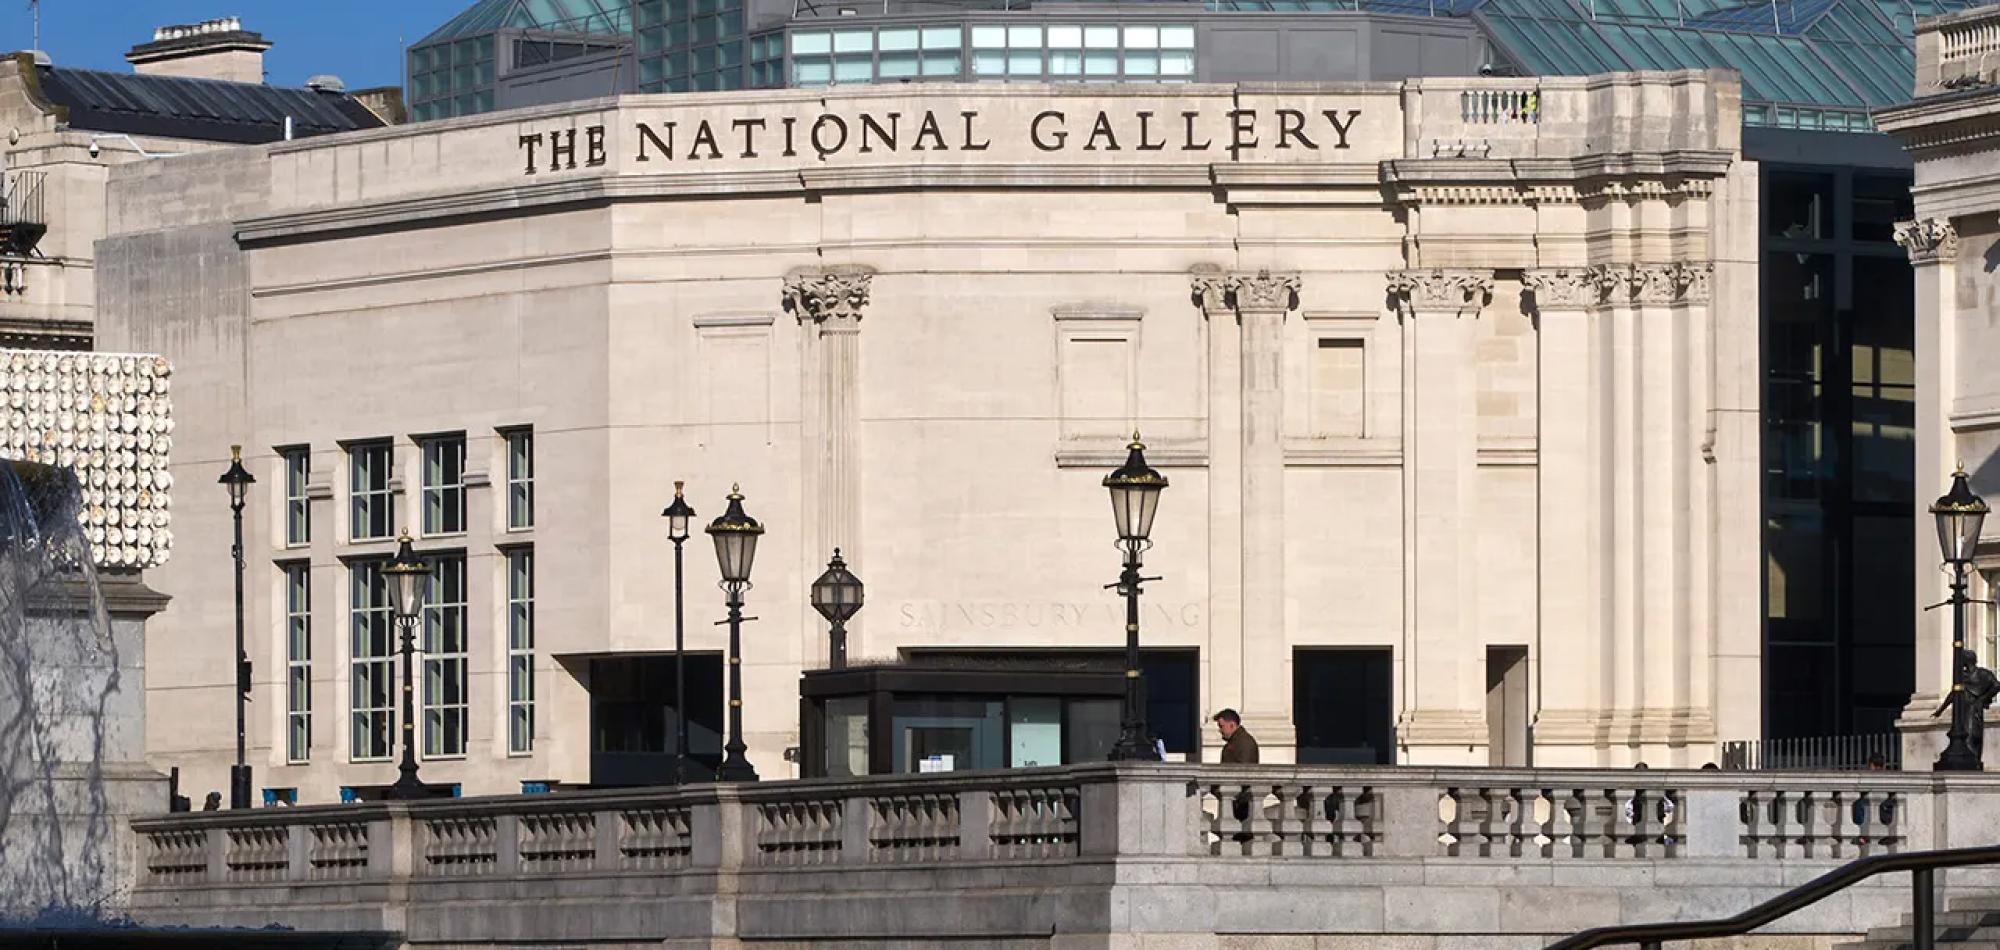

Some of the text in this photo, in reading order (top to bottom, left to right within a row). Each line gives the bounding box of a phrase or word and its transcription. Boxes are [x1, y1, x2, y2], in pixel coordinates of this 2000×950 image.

[519, 110, 1362, 175] THE NATIONAL GALLERY
[899, 602, 1089, 628] SAINSBURY
